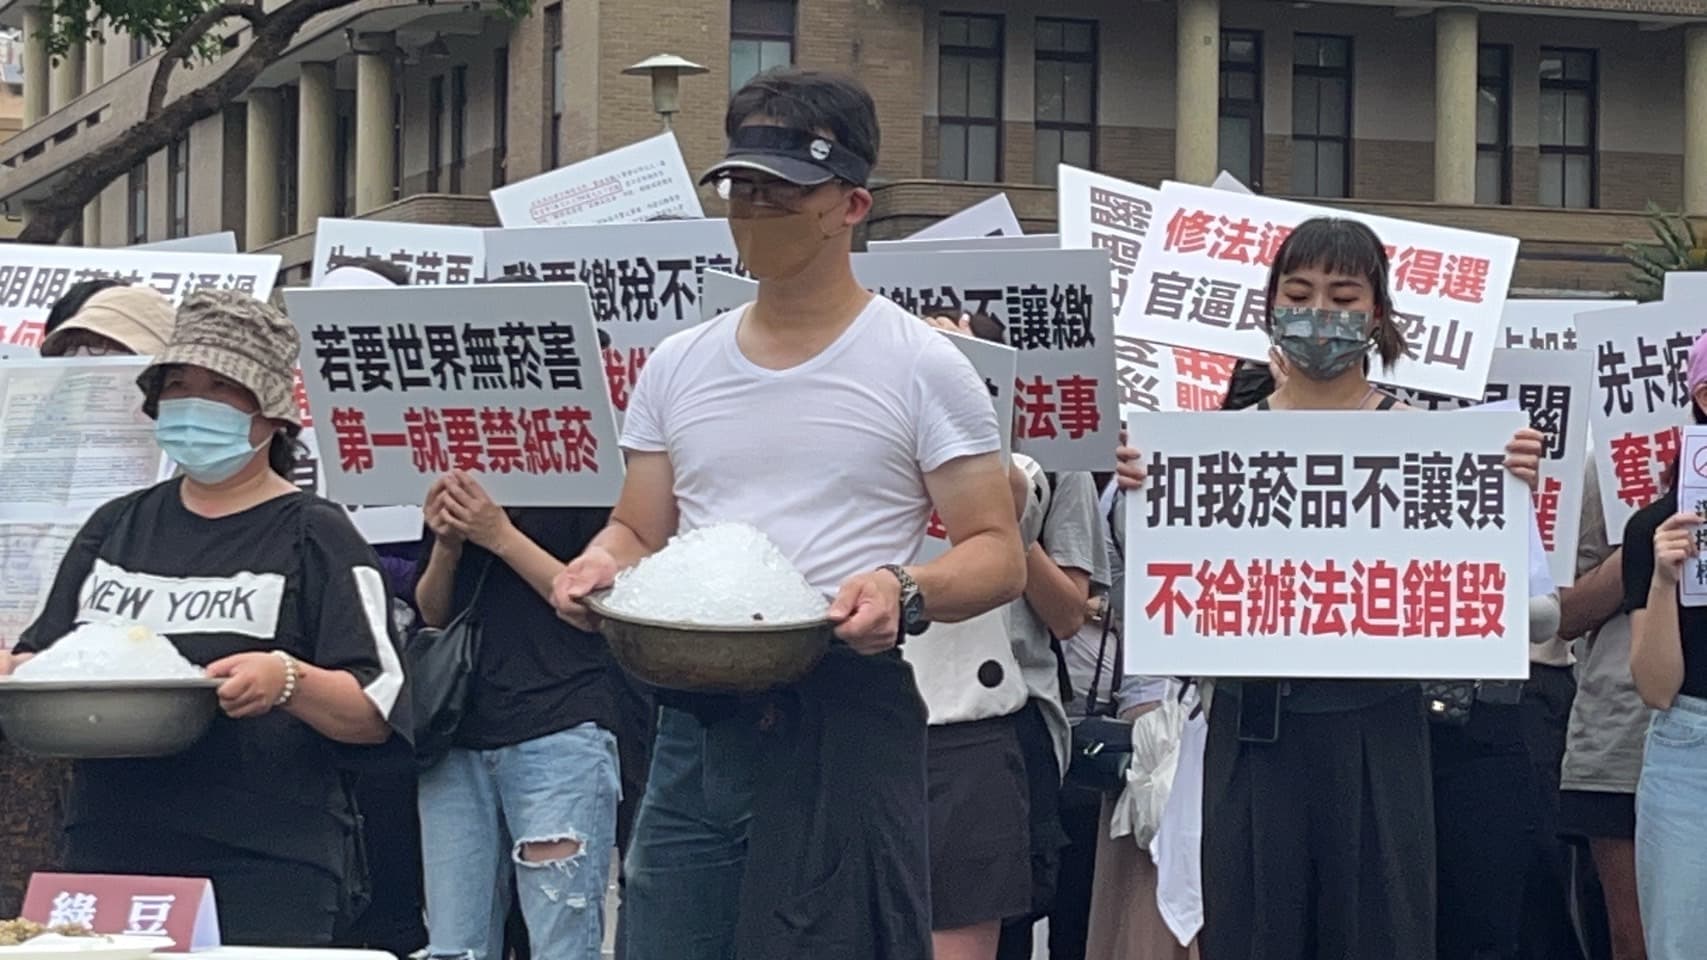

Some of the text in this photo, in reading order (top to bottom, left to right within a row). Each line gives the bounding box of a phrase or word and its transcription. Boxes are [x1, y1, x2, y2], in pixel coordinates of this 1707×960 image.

[1164, 207, 1490, 304] 修法通得選
[312, 321, 583, 391] 若要世界無菸害
[1150, 271, 1473, 371] 官逼良梁山
[1598, 329, 1706, 417] 先卡疫
[331, 406, 599, 473] 第一就要禁紙菸
[1146, 451, 1507, 530] 扣我菸品不讓領
[166, 587, 258, 622] YORK
[1145, 559, 1507, 639] 不給辦法迫銷毀
